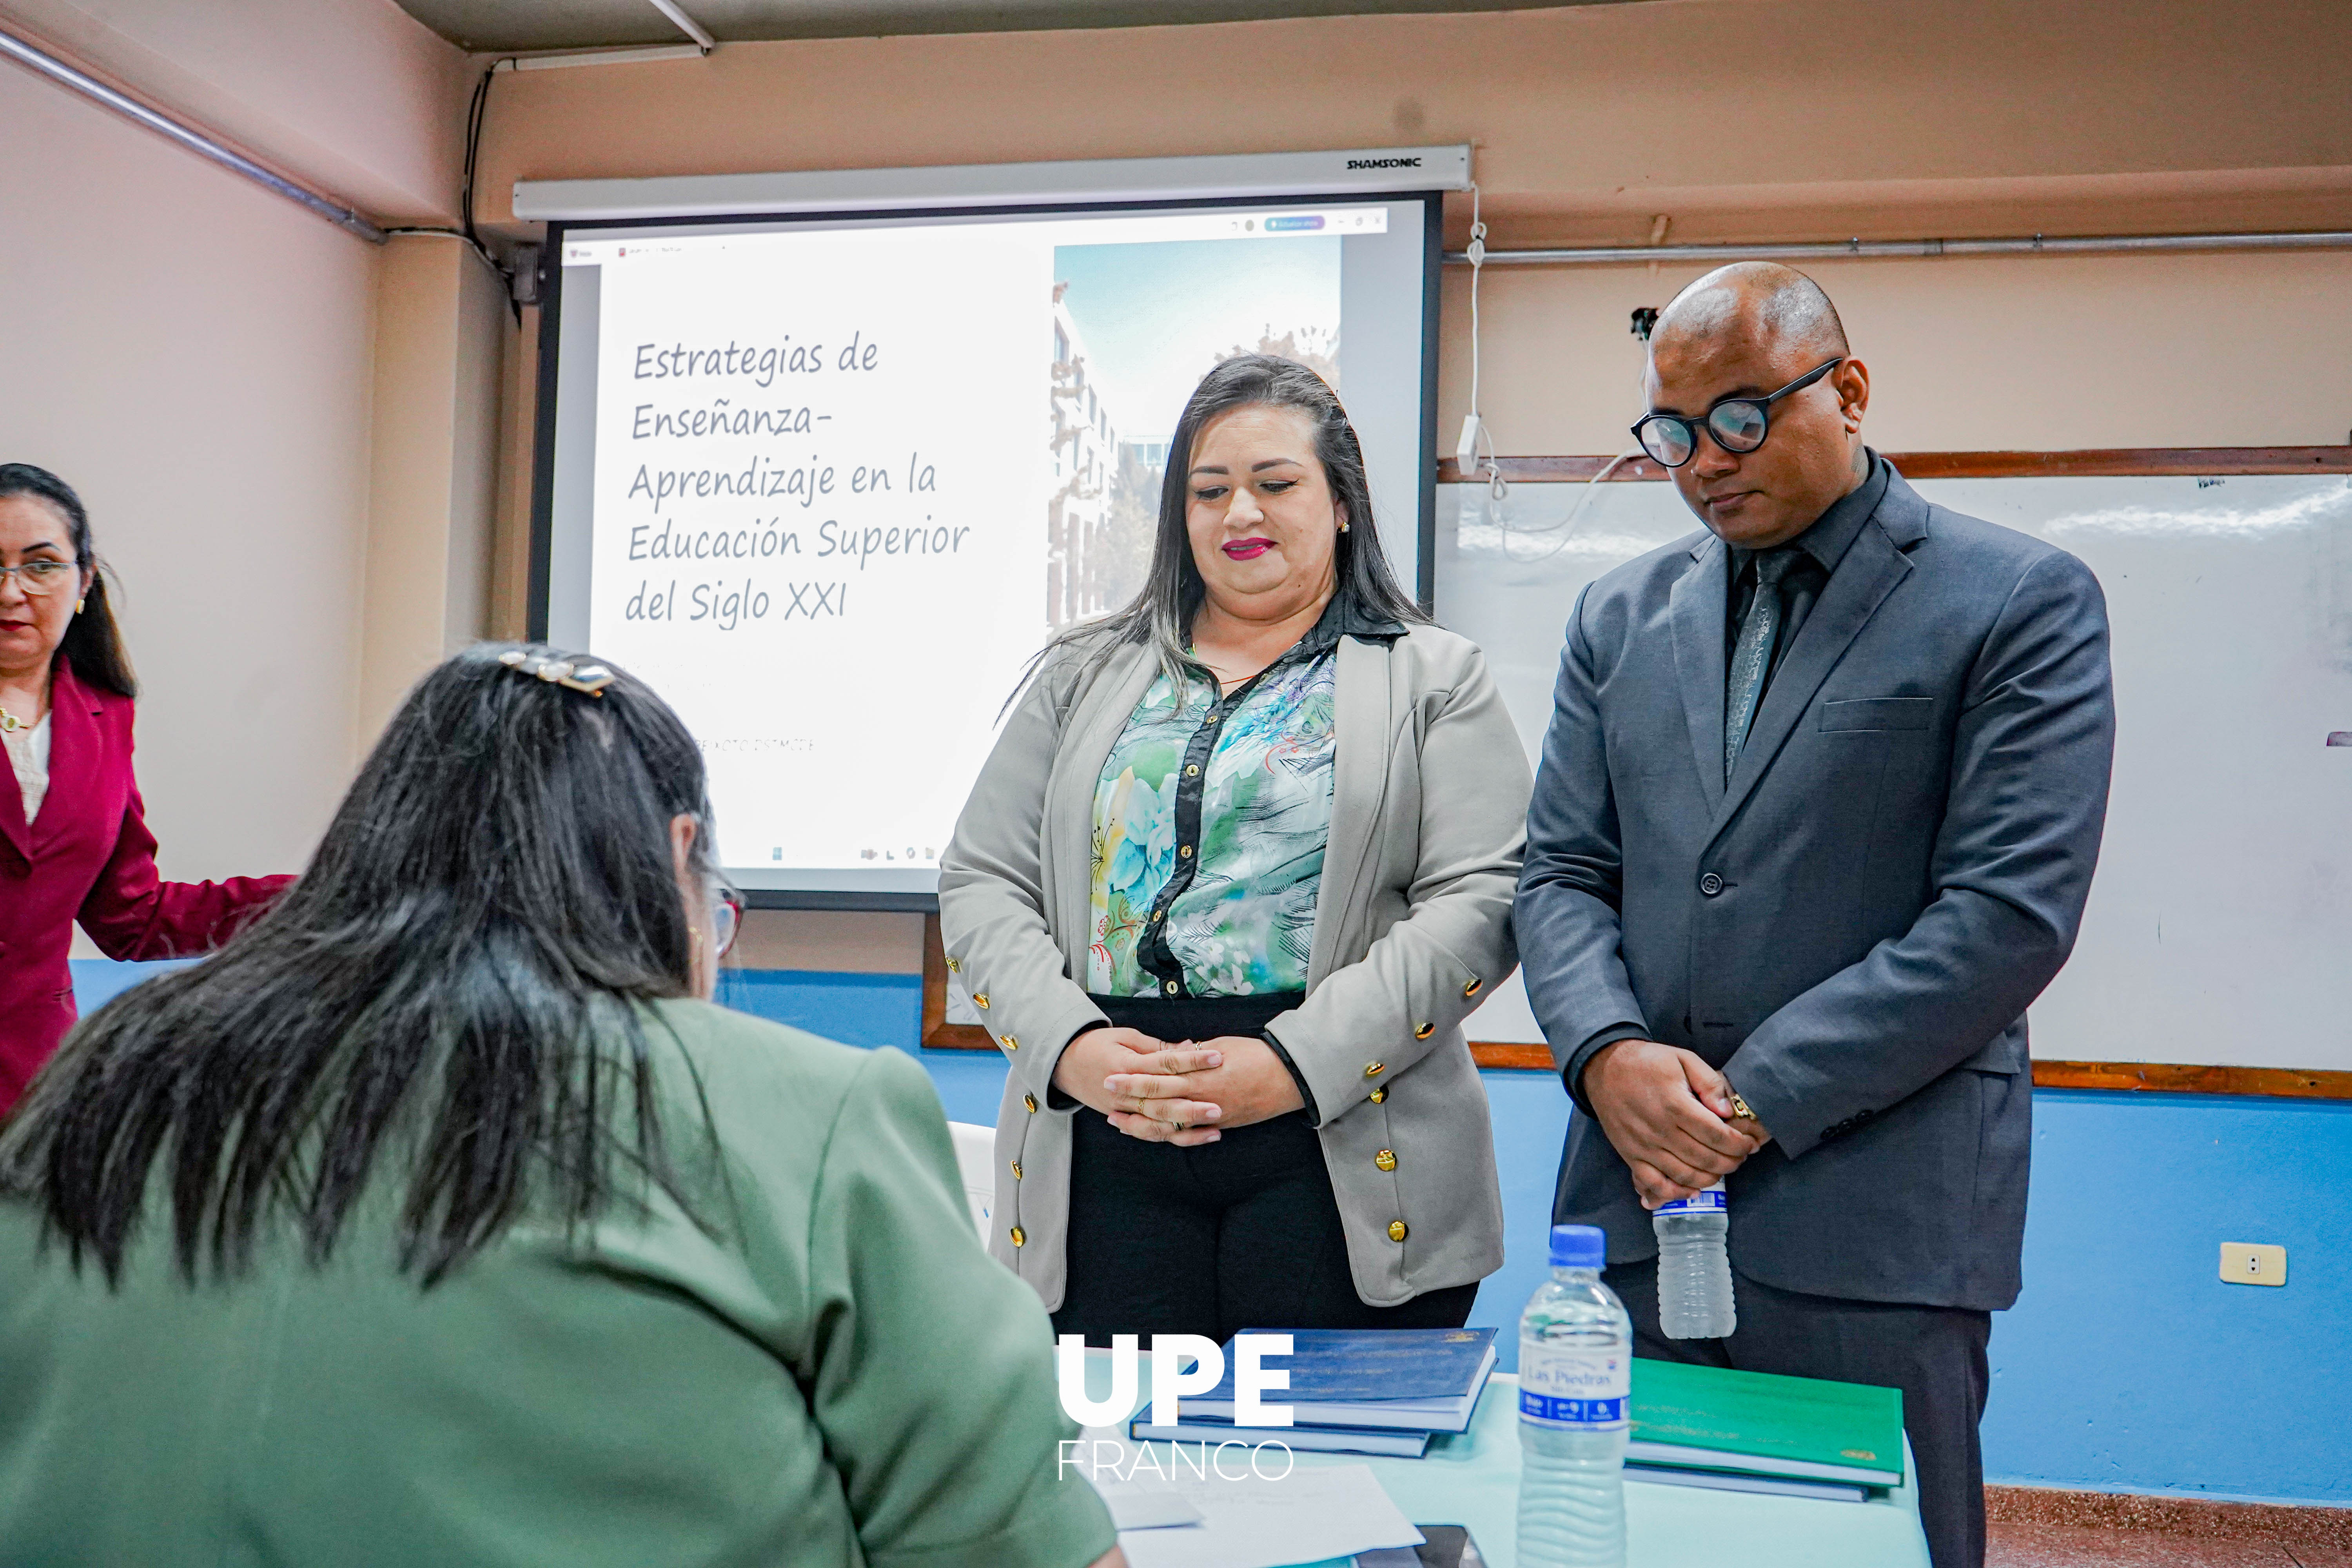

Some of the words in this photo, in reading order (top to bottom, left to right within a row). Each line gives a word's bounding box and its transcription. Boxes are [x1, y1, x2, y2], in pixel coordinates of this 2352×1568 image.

[1347, 157, 1421, 170] SHAMSONIC
[634, 334, 823, 388] Estrategias
[838, 330, 878, 371] de
[632, 398, 832, 440] Enseñanza-
[628, 454, 835, 515] Aprendizaje
[851, 466, 891, 494] en
[909, 451, 936, 493] la
[628, 516, 802, 561] Educación
[817, 514, 970, 571] Superior
[625, 579, 676, 621] del
[690, 578, 769, 631] Siglo
[784, 582, 846, 621] XXI
[1528, 1365, 1549, 1381] Las
[1555, 1369, 1610, 1385] Piedras
